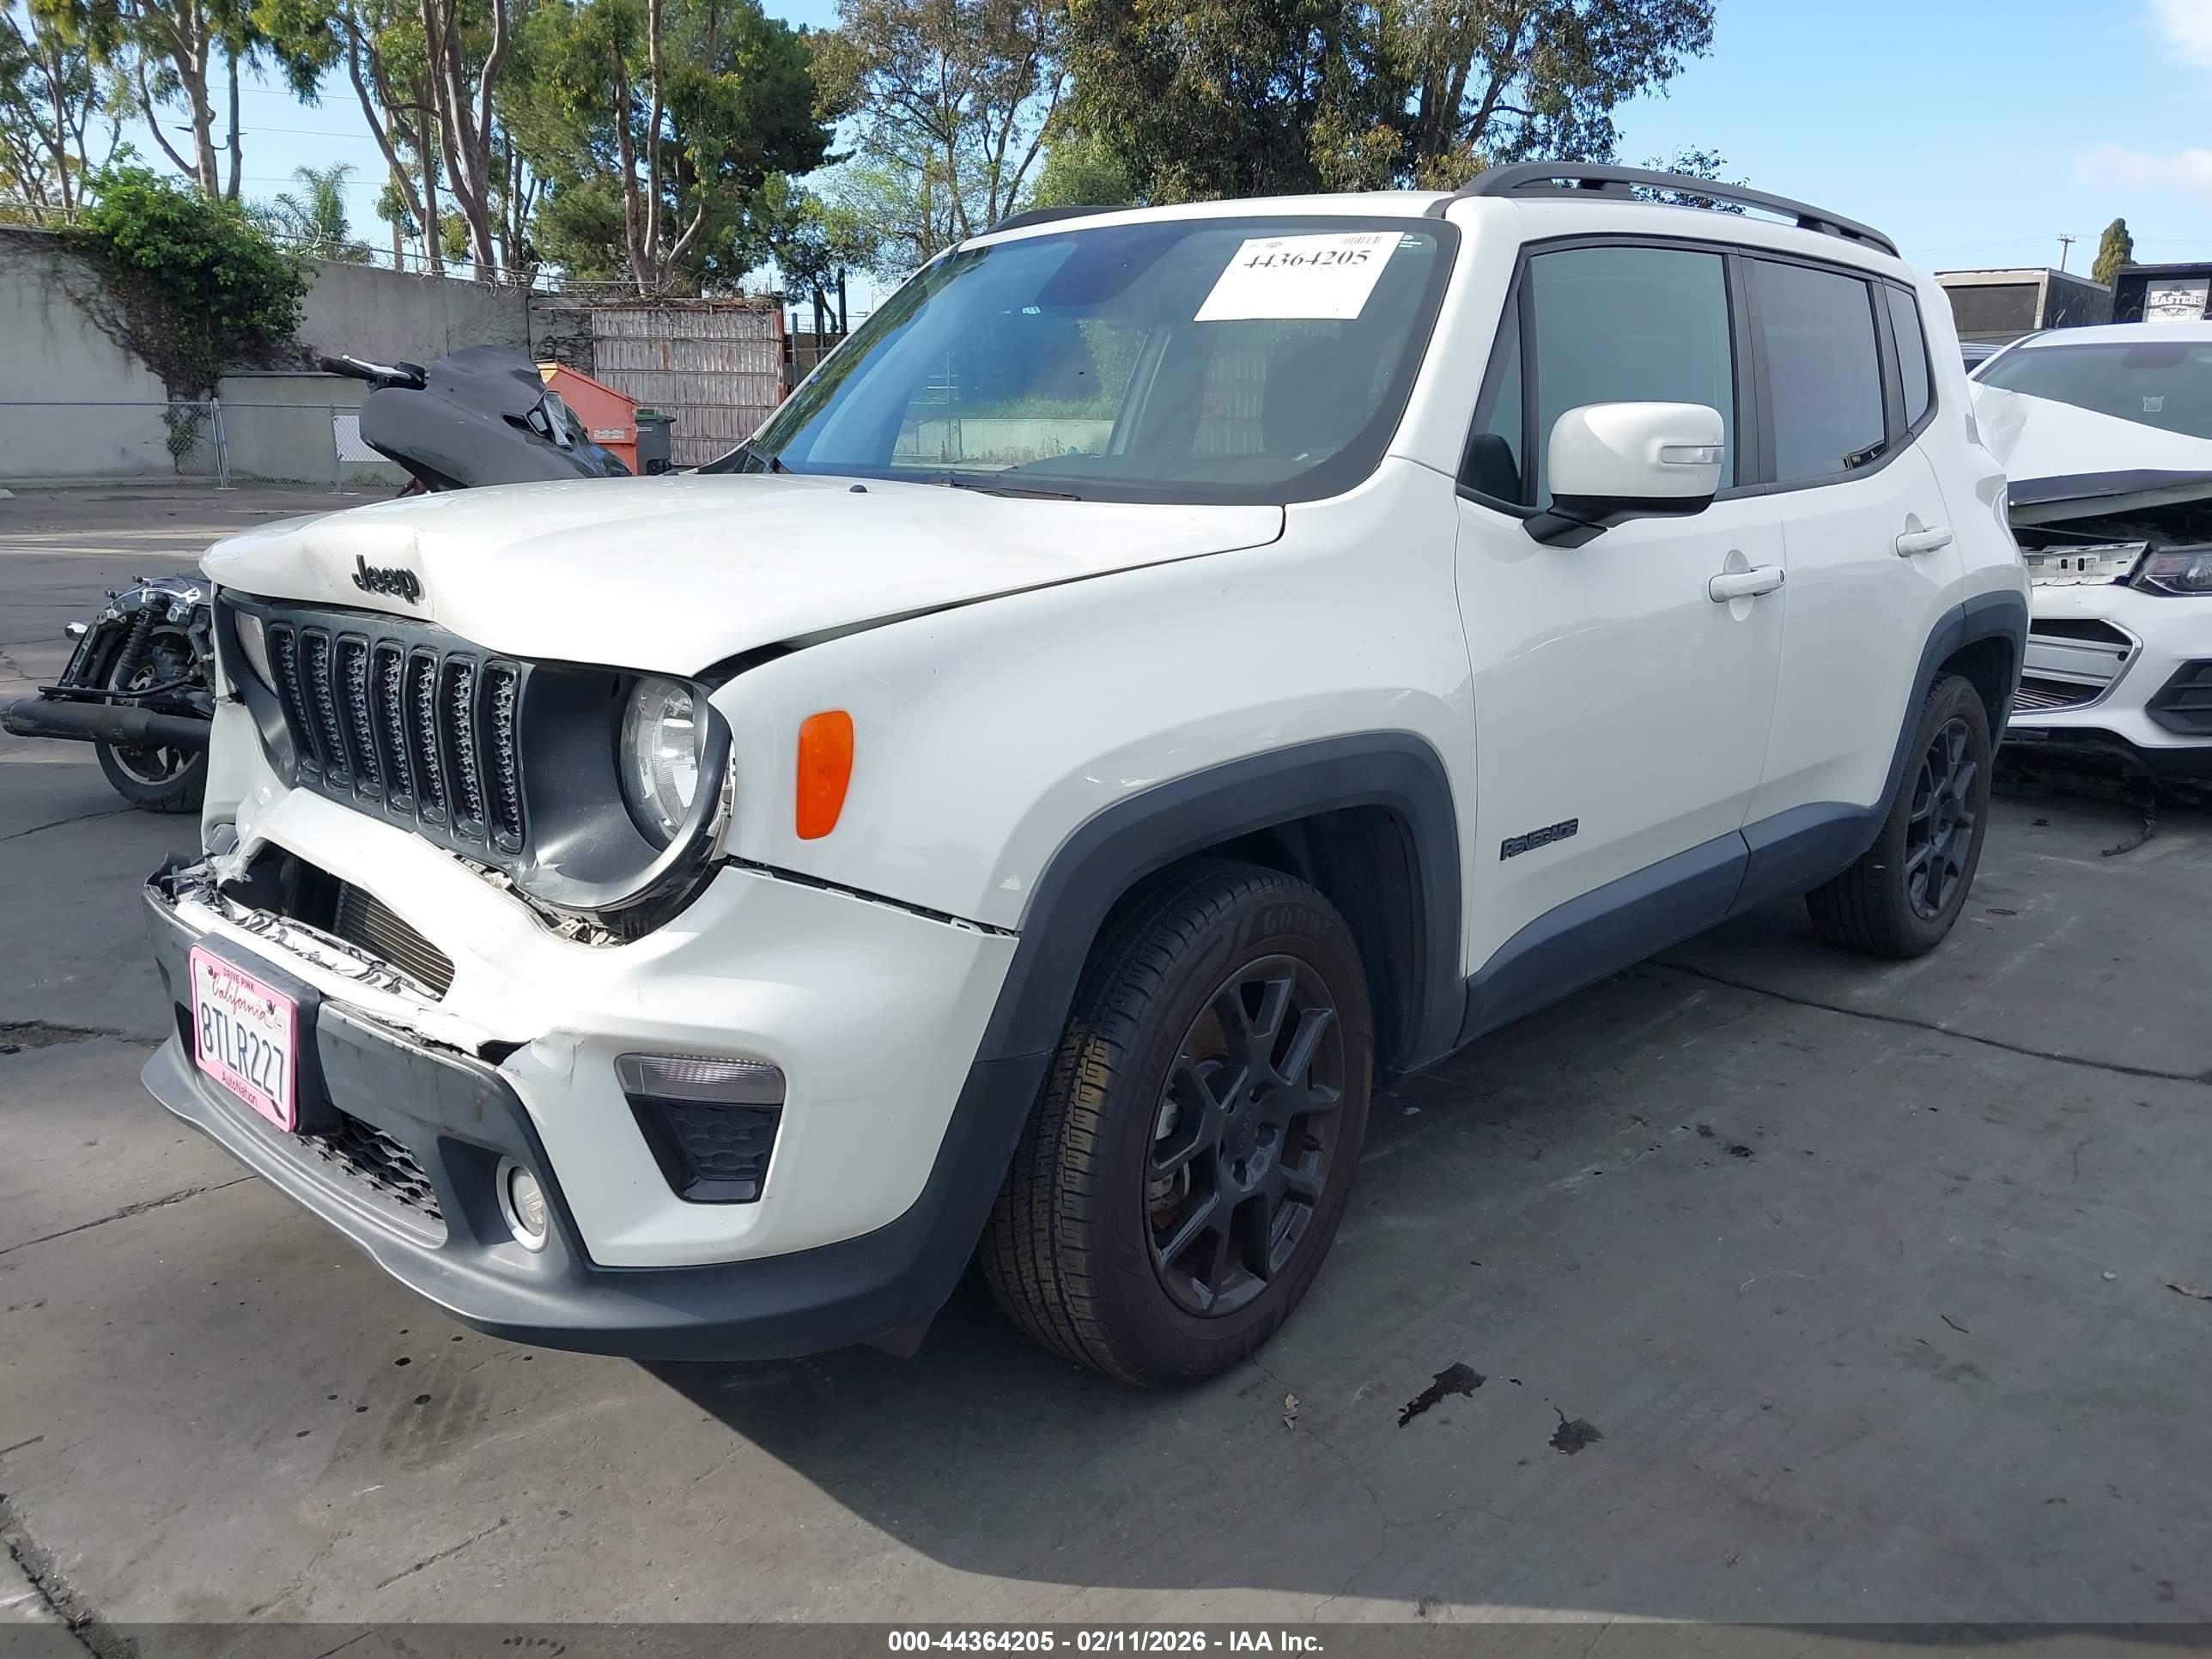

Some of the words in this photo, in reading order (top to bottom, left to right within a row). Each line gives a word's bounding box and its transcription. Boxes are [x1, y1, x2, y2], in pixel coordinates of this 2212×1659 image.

[1244, 249, 1372, 269] 44364205
[2148, 295, 2205, 307] MASTERS
[350, 554, 421, 605] Jeep
[1499, 817, 1579, 861] RENEGADE
[211, 972, 272, 1029] California
[222, 967, 240, 984] DRIVE
[240, 975, 255, 993] PINK
[200, 1000, 285, 1104] 8TLR227
[221, 1070, 258, 1108] AutoNation
